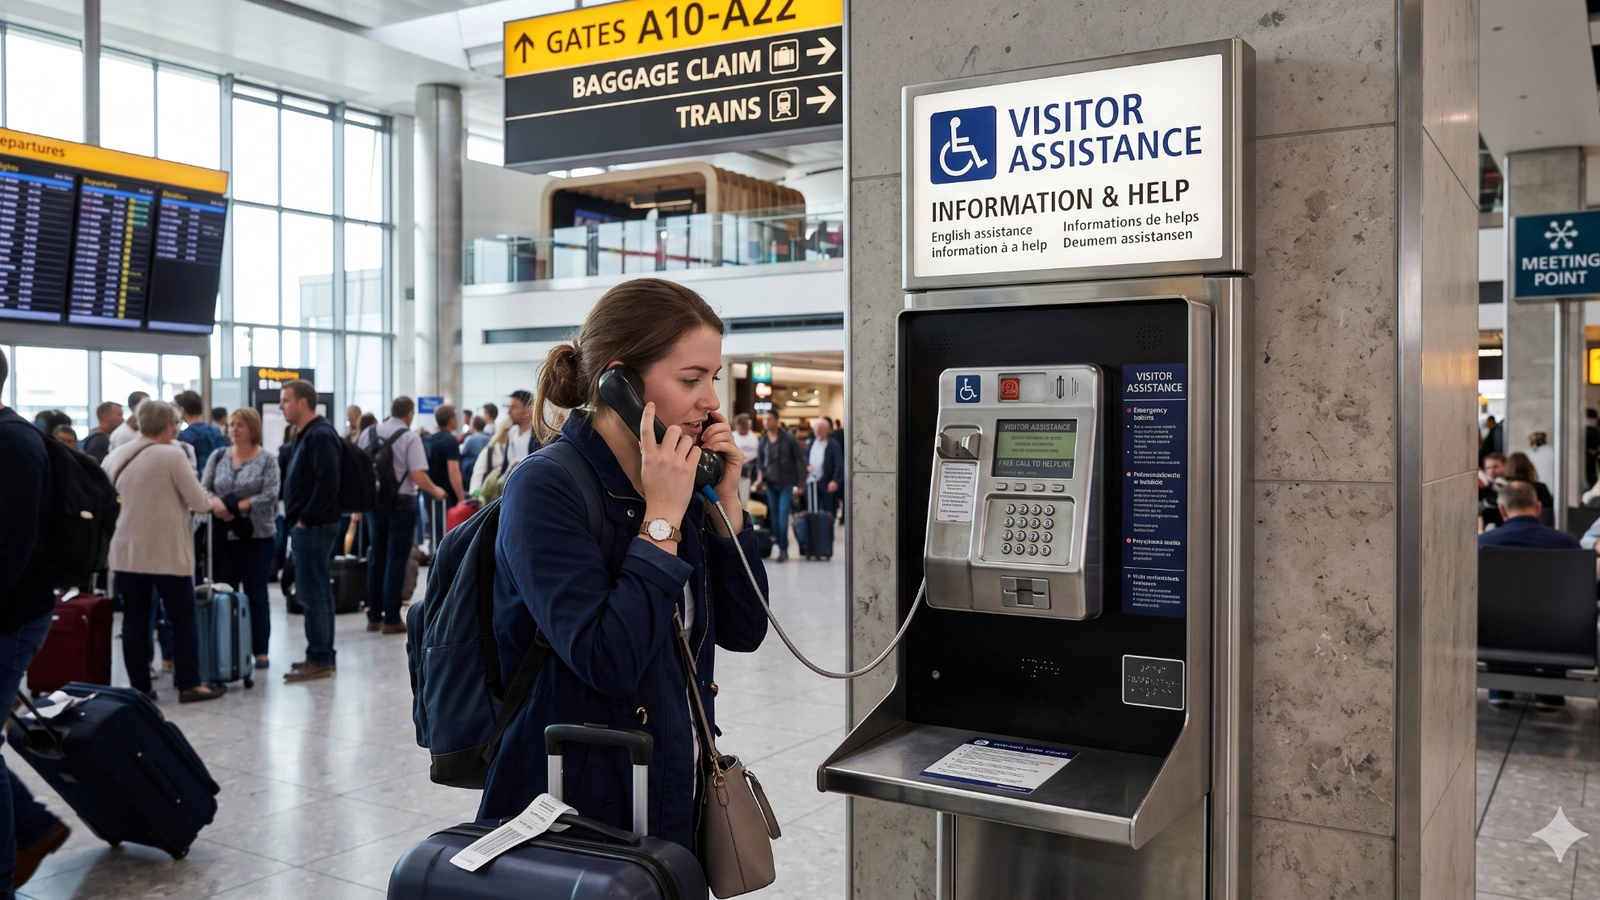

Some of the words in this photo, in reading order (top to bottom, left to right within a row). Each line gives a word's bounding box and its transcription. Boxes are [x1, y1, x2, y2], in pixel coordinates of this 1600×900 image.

[547, 19, 626, 54] GATES
[637, 0, 796, 45] A10-A22
[572, 61, 679, 99] BAGGAGE
[686, 50, 761, 81] CLAIM
[676, 96, 761, 129] TRAINS
[1008, 93, 1144, 138] VISITOR
[0, 137, 66, 158] epartures
[1008, 125, 1202, 174] ASSISTANCE
[931, 187, 1093, 223] INFORMATION
[1102, 185, 1119, 208] &
[1128, 178, 1190, 206] HELP
[1063, 216, 1142, 233] Informations
[1145, 214, 1161, 226] de
[1165, 211, 1200, 226] helps
[931, 229, 971, 244] English
[974, 225, 1033, 241] assistance
[1063, 234, 1117, 249] Deumem
[1121, 229, 1193, 245] assistansen
[931, 243, 998, 258] information
[1001, 241, 1008, 254] à
[1011, 244, 1018, 253] a
[1022, 239, 1048, 254] help
[1522, 253, 1600, 270] MEETING
[1534, 270, 1588, 287] POINT
[1136, 371, 1172, 381] VISITOR
[1126, 382, 1183, 393] ASSISTANCE
[1133, 407, 1168, 415] Emergency
[1004, 423, 1029, 431] VISITOR
[1030, 423, 1071, 431] ASSISTANCE
[1032, 460, 1041, 468] TO
[1042, 460, 1072, 468] HELPLINE
